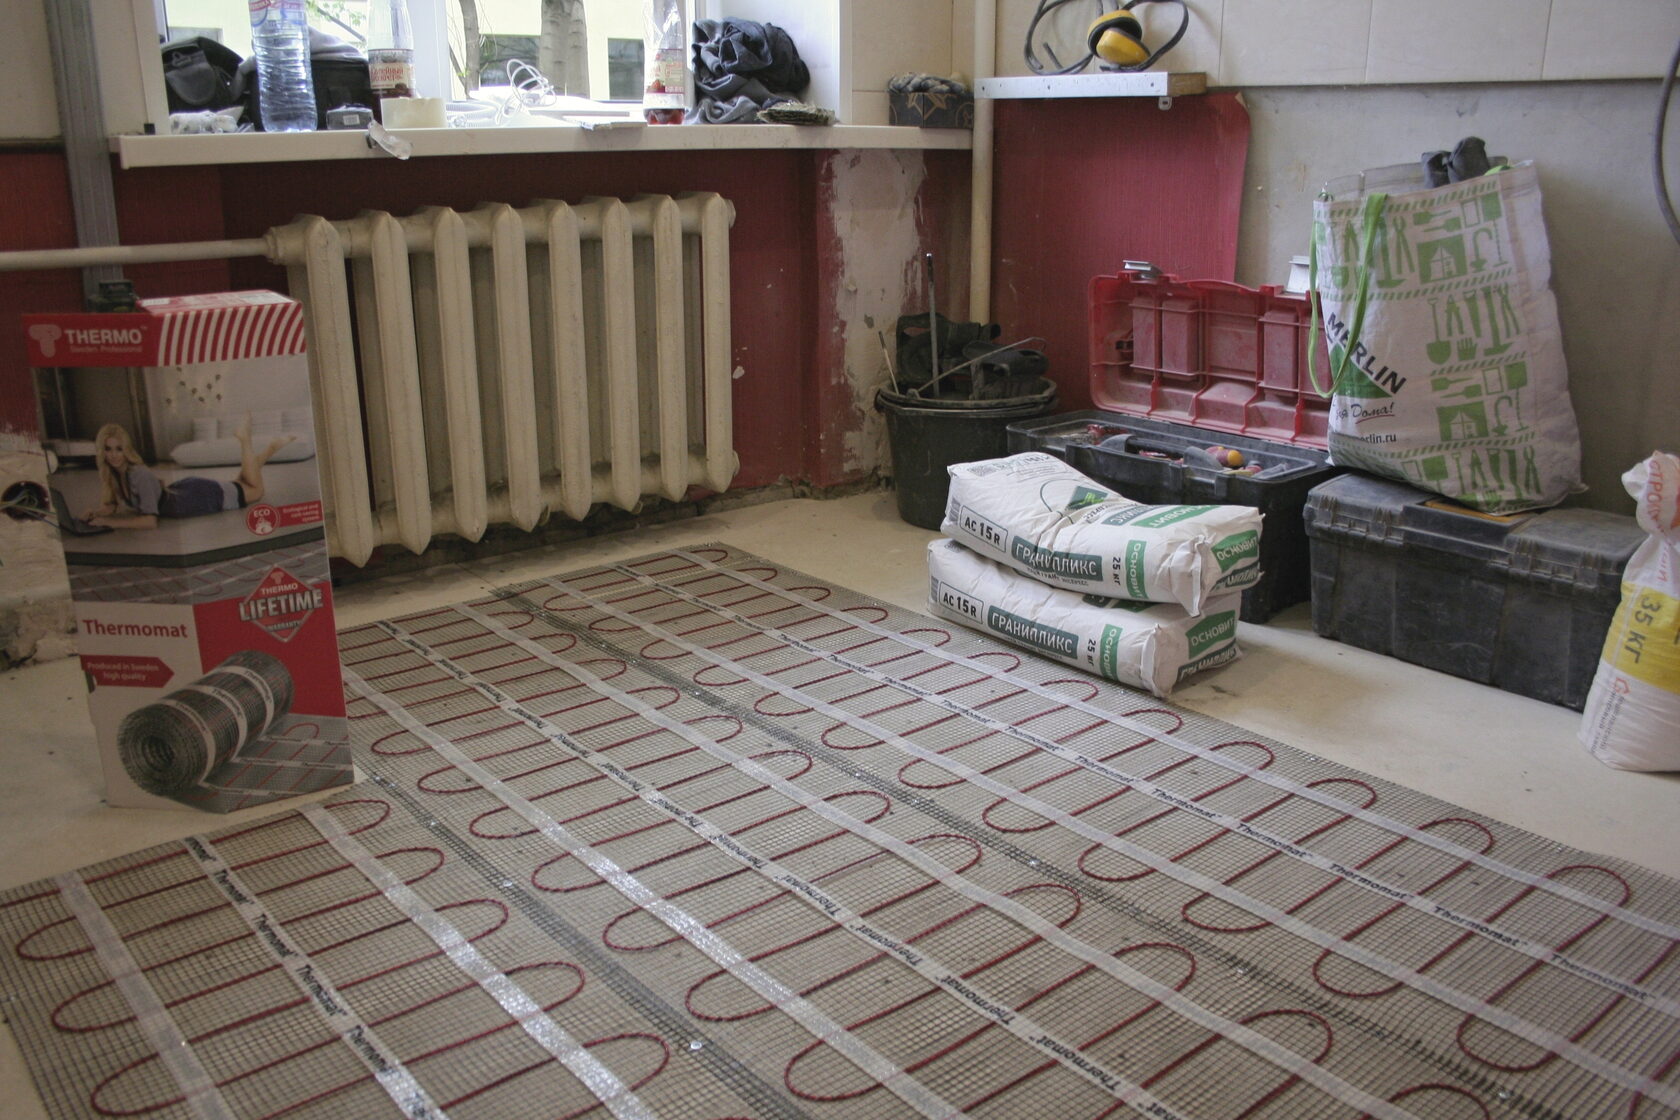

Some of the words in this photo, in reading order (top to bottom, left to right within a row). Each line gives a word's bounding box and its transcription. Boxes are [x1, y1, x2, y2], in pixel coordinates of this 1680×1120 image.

[64, 329, 142, 344] THERMO
[1327, 312, 1407, 394] MERLIN
[253, 508, 271, 518] ECO
[979, 522, 993, 540] 15
[993, 533, 1001, 546] R
[1217, 536, 1259, 561] ОСНОВИТ
[1015, 543, 1097, 576] ГРАНИПЛИКС
[1112, 556, 1121, 571] 25
[260, 582, 298, 595] THERMO
[239, 588, 324, 622] LIFETIME
[956, 595, 969, 614] 15
[970, 605, 977, 618] R
[1634, 597, 1661, 627] 35
[82, 619, 188, 638] Thermomat
[991, 611, 1073, 654] ГРАНИПЛИКС
[1191, 617, 1236, 647] ОСНОВИТ
[1087, 639, 1097, 653] 25
[1004, 725, 1059, 752] Thermomat
[1074, 755, 1134, 783] Thermomat
[1151, 788, 1217, 819] Thermomat
[1236, 823, 1307, 858] Thermomat
[782, 874, 842, 916] Thermomat
[1329, 863, 1409, 899] Thermomat
[1434, 906, 1521, 947] Thermomat
[860, 924, 923, 966] Thermomat
[1551, 953, 1648, 1000] Thermomat
[939, 975, 1017, 1026] Thermomat
[1034, 1035, 1121, 1091] Thermomat
